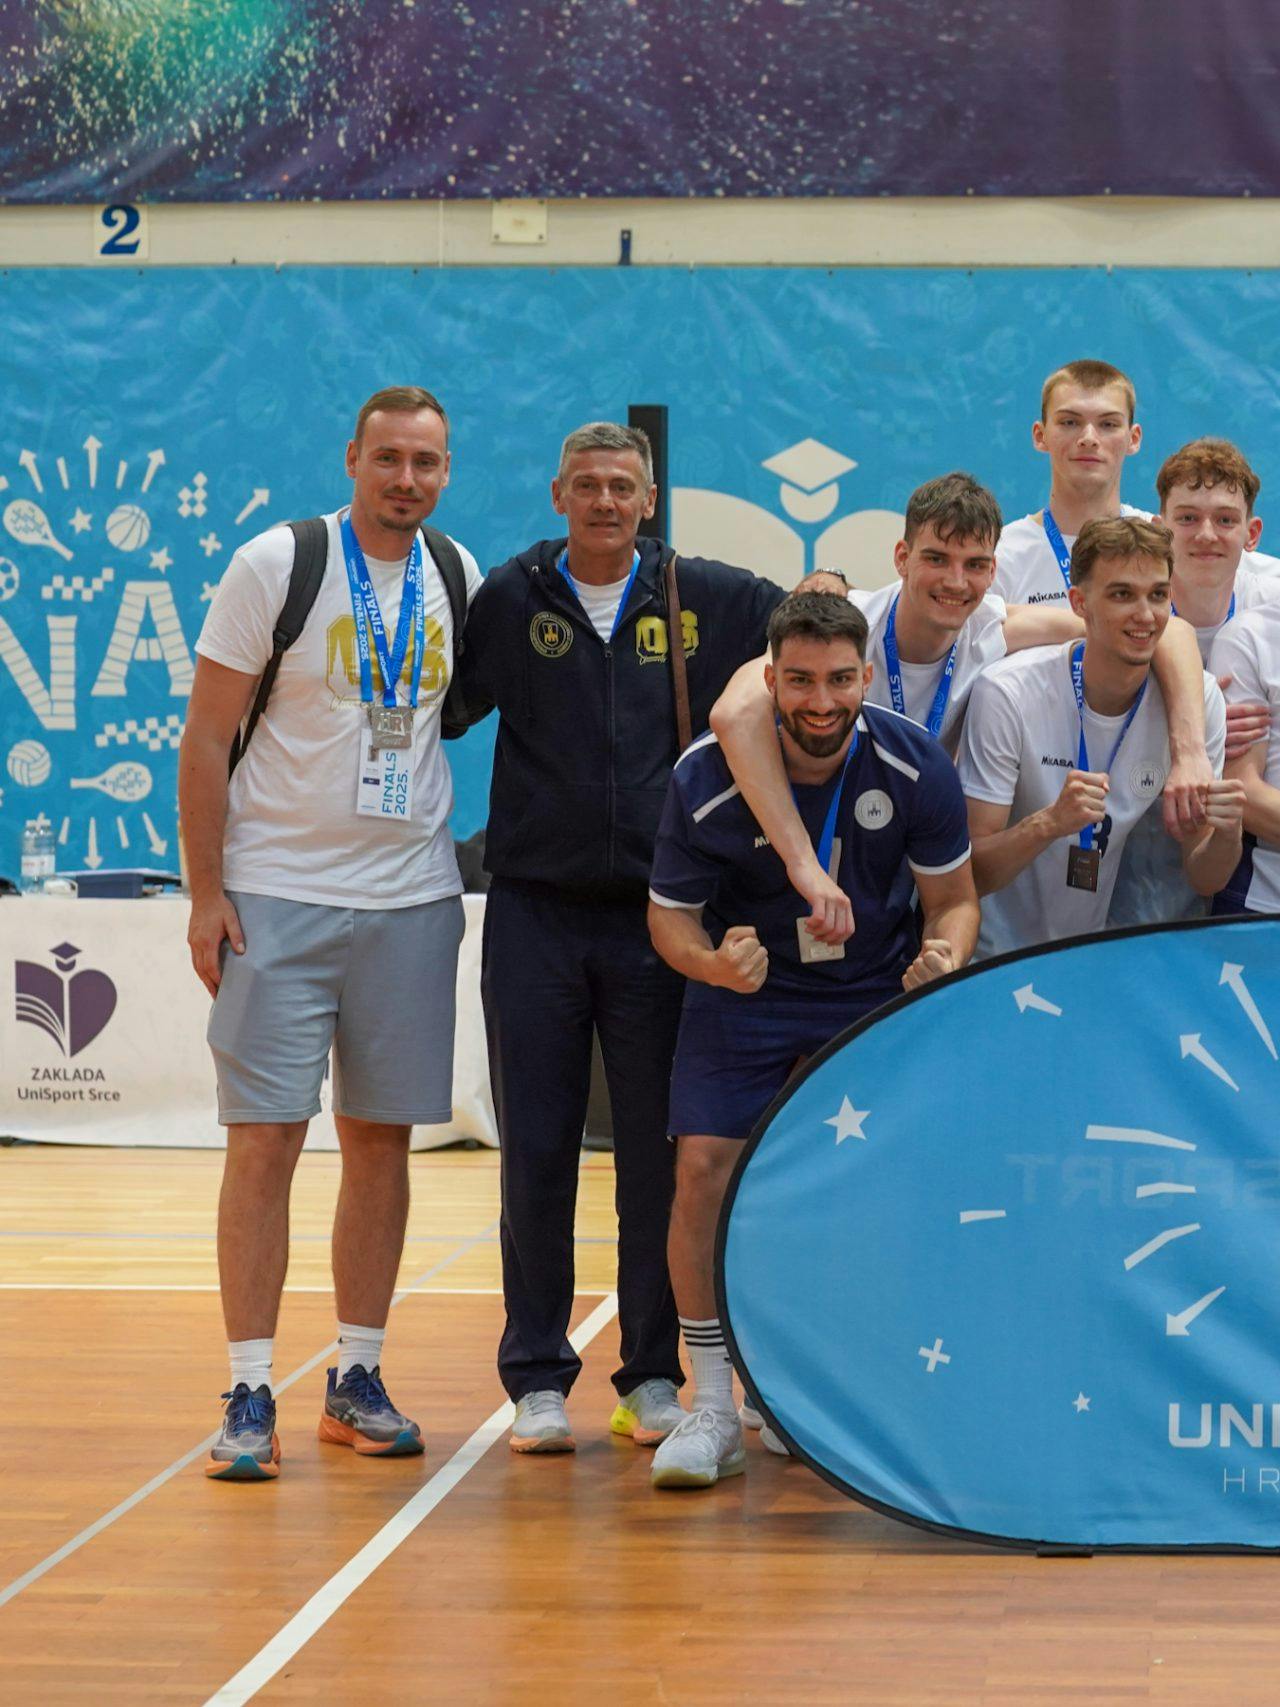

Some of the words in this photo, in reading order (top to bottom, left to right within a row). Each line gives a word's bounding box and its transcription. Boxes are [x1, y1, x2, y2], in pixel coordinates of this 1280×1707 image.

[101, 204, 141, 254] 2
[353, 593, 366, 631] FINALS
[361, 581, 384, 635] FINALS
[415, 590, 424, 631] FINALS
[1072, 661, 1084, 708] FINAL
[382, 752, 397, 813] FINALS
[394, 769, 409, 815] 2025.
[17, 1087, 84, 1103] UniSport
[88, 1087, 121, 1102] Srce
[31, 1067, 106, 1081] ZAKLADA
